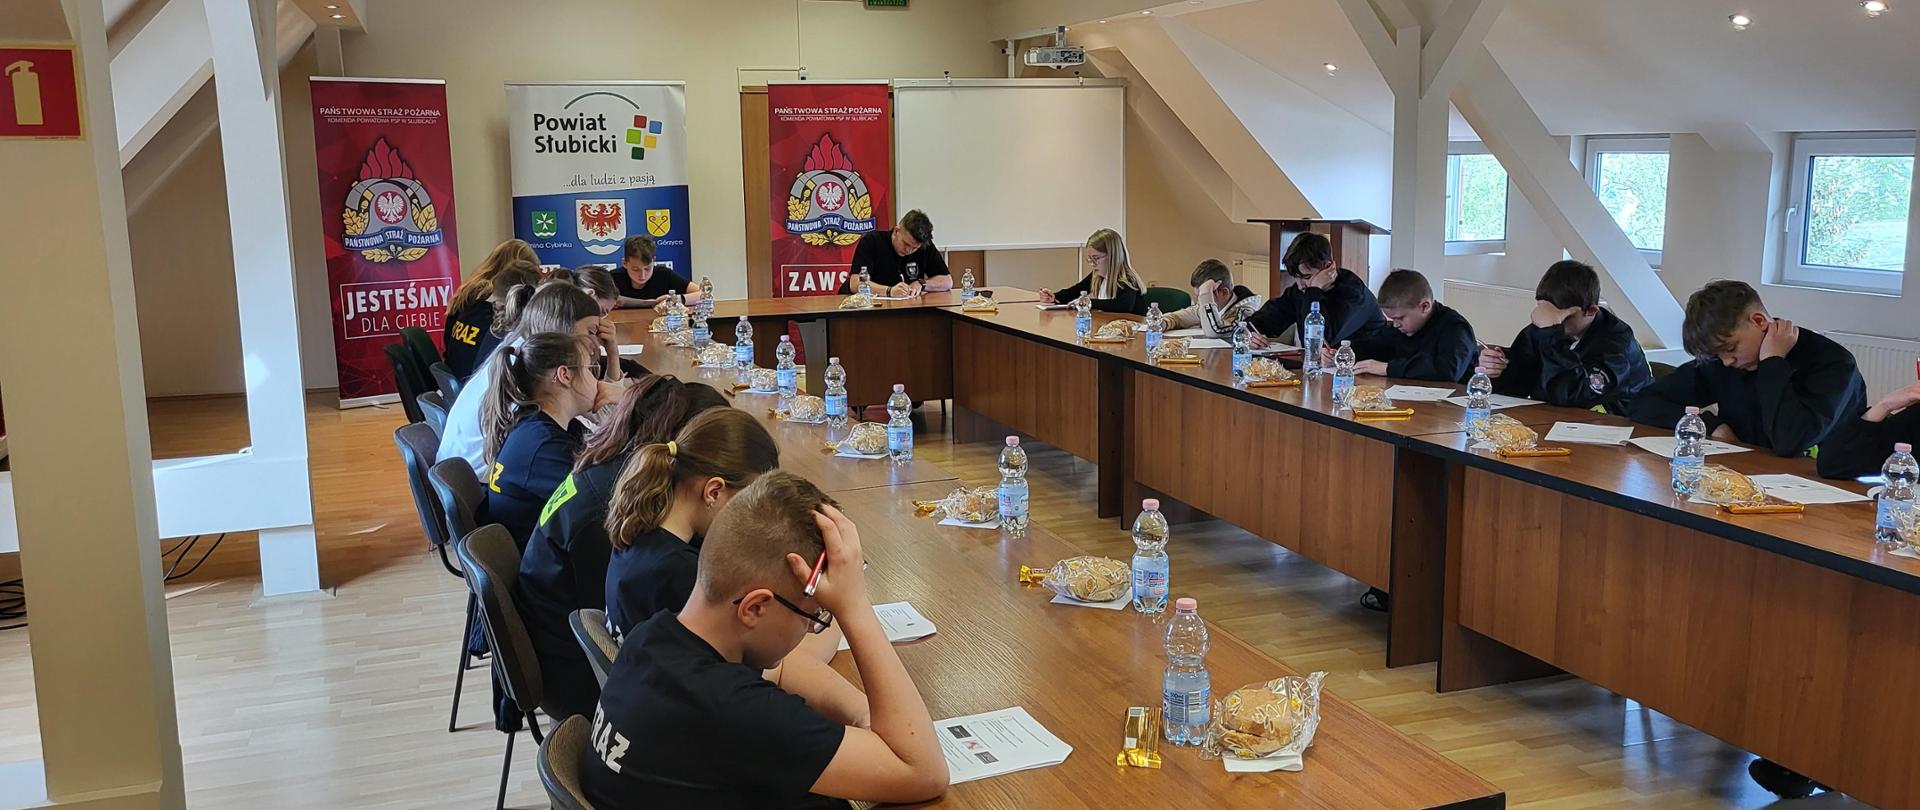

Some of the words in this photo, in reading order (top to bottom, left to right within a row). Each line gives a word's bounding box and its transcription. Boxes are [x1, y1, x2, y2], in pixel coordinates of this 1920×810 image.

[319, 106, 376, 116] PAŃSTWOWA
[377, 107, 404, 116] STRAŻ
[404, 108, 441, 116] POŻARNA
[774, 106, 823, 114] PAŃSTWOWA
[824, 106, 848, 114] STRAŻ
[848, 106, 882, 114] POŻARNA
[533, 112, 607, 131] Powiat
[534, 135, 617, 153] Słubicki
[590, 173, 617, 185] ludzi
[620, 176, 626, 184] z
[629, 172, 656, 186] pasją
[385, 229, 404, 240] STRAŻ
[545, 241, 573, 249] Cybinka
[788, 271, 849, 292] ZAWS
[346, 282, 450, 320] JESTEŚMY
[361, 315, 390, 333] DLA
[395, 311, 441, 330] CIEBIE
